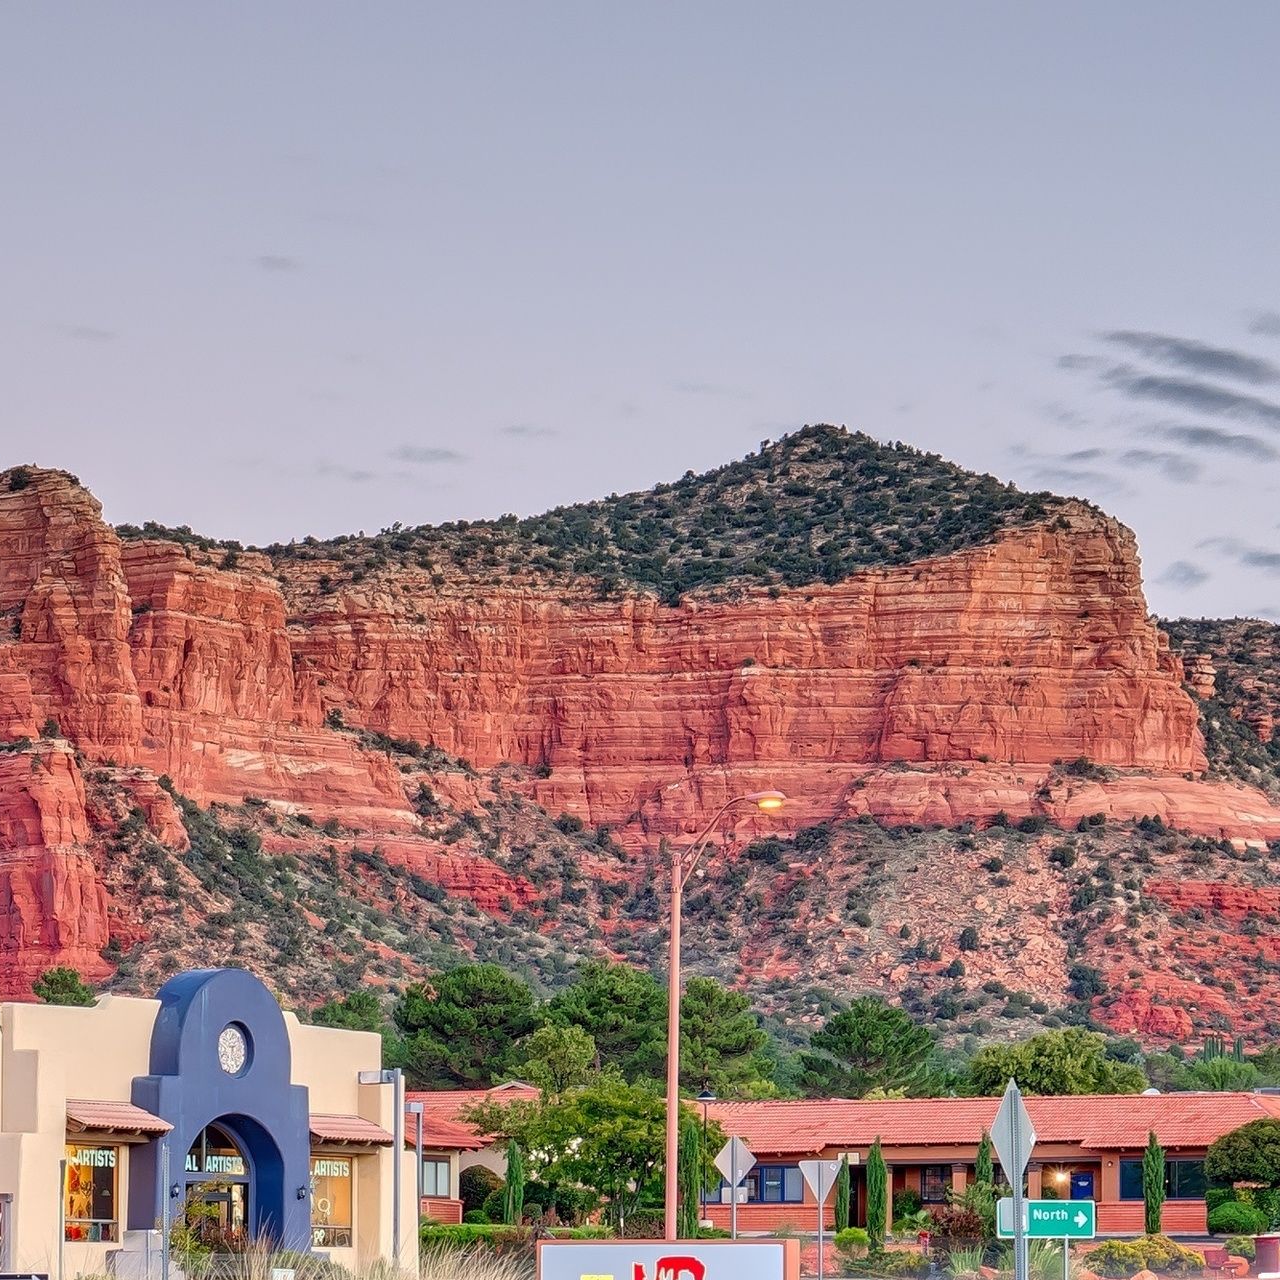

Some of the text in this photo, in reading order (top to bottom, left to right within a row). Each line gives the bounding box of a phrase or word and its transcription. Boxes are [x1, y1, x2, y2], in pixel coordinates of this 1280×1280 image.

[77, 1149, 116, 1168] ARTISTS
[314, 1160, 350, 1177] ARTISTS
[1033, 1208, 1069, 1221] North
